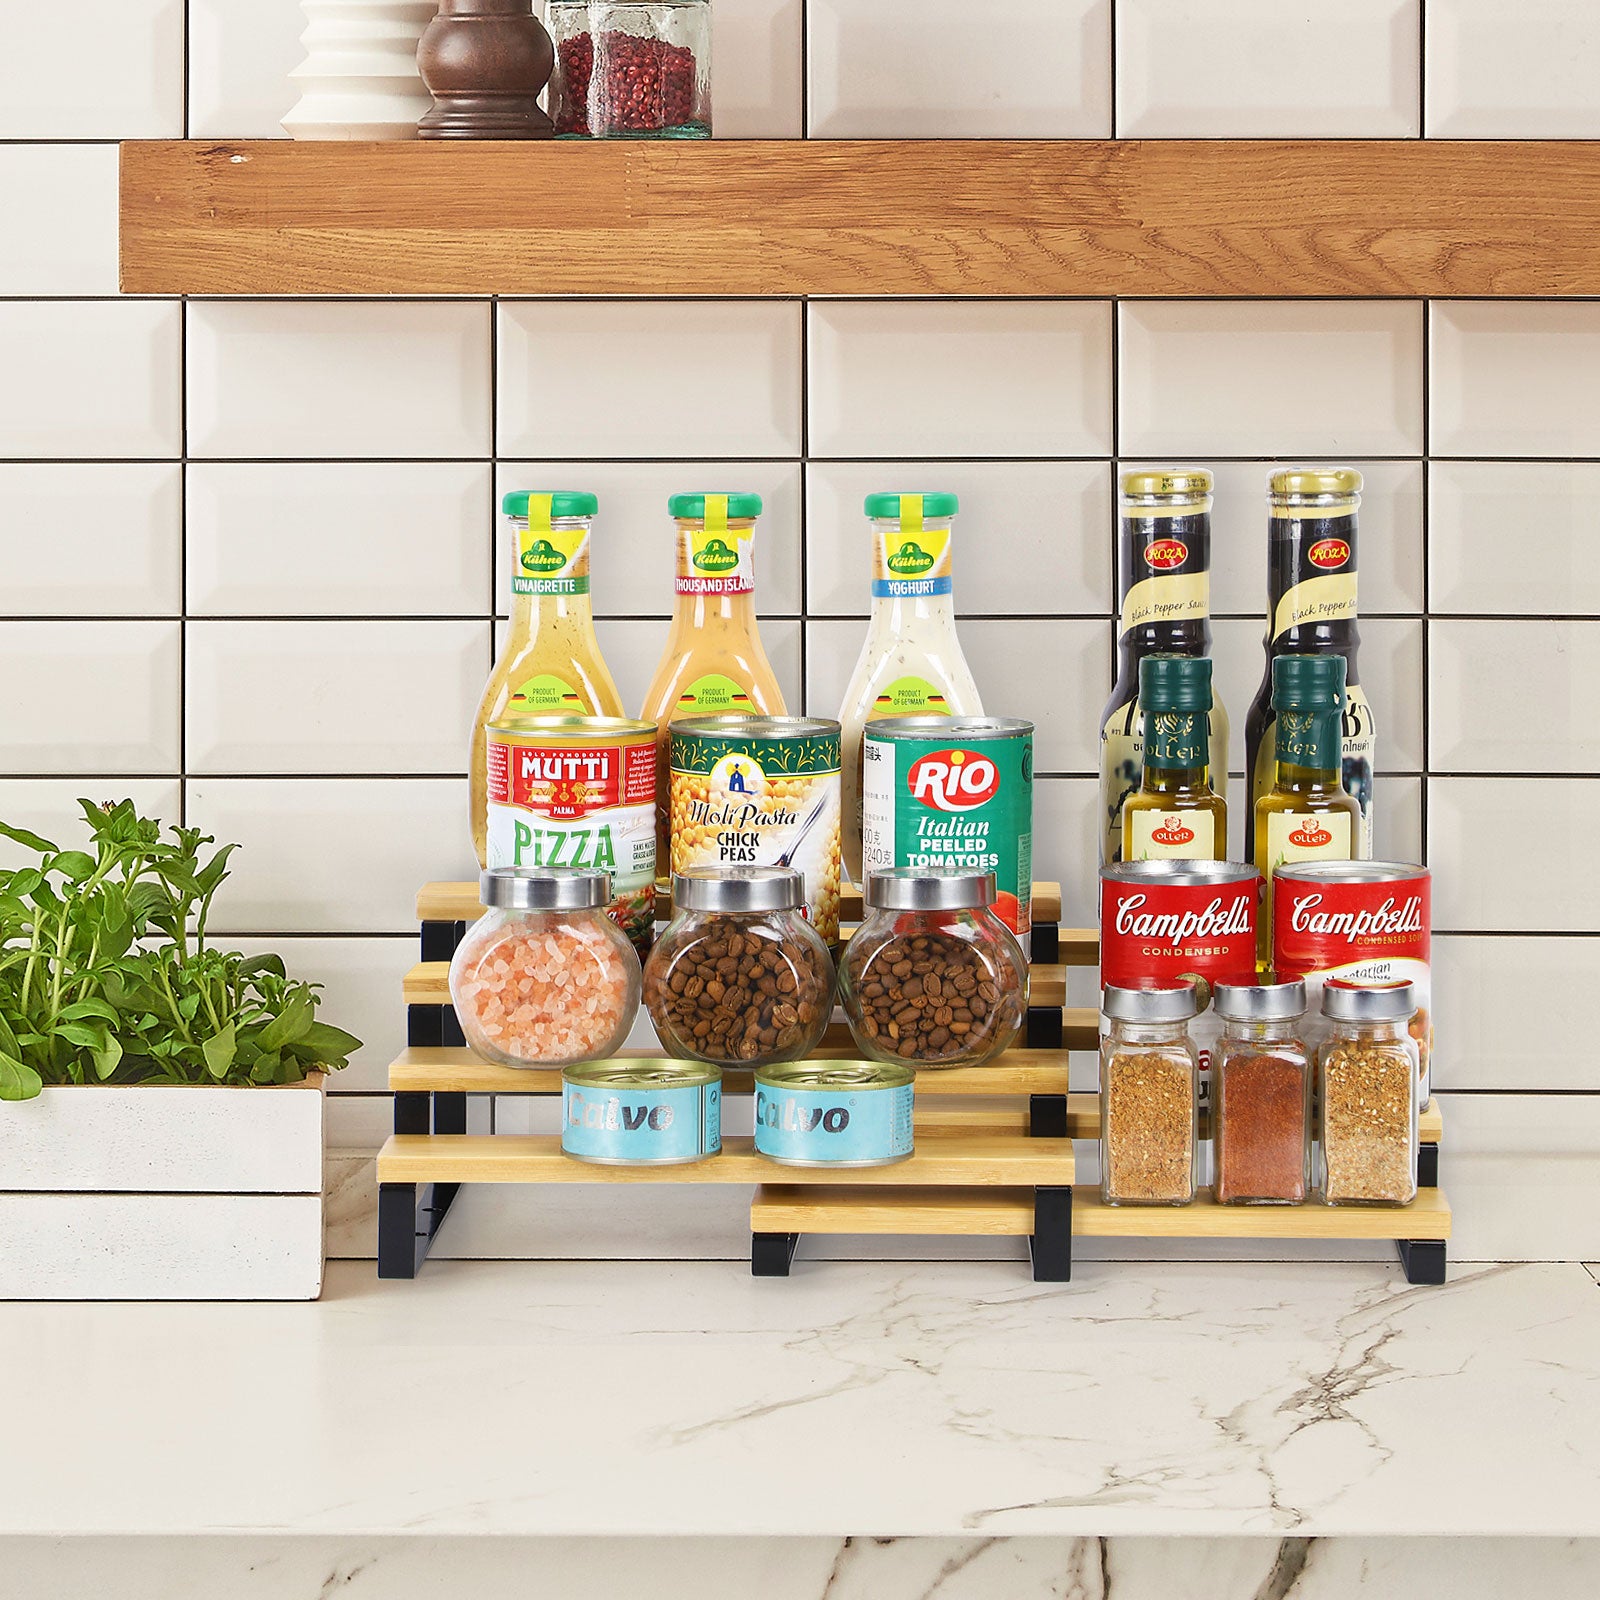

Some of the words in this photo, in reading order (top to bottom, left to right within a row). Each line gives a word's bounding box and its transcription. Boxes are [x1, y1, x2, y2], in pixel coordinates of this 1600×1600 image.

[524, 554, 563, 564] Kühne
[696, 554, 736, 564] Kühne
[1147, 547, 1185, 560] ROZA
[1311, 546, 1348, 561] ROZA
[890, 556, 931, 567] Kühne
[514, 578, 576, 593] VINAIGRETTE
[675, 578, 723, 592] THOUSAND
[888, 581, 935, 595] YOGHURT
[1153, 602, 1185, 616] Pepper
[1291, 604, 1316, 622] Black
[1318, 601, 1347, 616] Pepper
[702, 688, 725, 696] PRODUCT
[706, 697, 730, 705] GERMANY
[521, 757, 609, 780] MUTTI
[553, 806, 575, 816] PARMA
[916, 816, 989, 837] Italian
[513, 819, 616, 868] PIZZA
[717, 832, 760, 847] CHICK
[920, 839, 987, 852] PEELED
[720, 848, 756, 862] PEAS
[906, 854, 999, 868] TOMATOES
[1115, 893, 1251, 947] Campbell's
[1291, 893, 1423, 944] Campbell's
[1357, 936, 1407, 945] CONDENSED
[1142, 946, 1230, 957] CONDENSED
[568, 1092, 674, 1132] Calvo
[756, 1091, 851, 1134] Calvo
